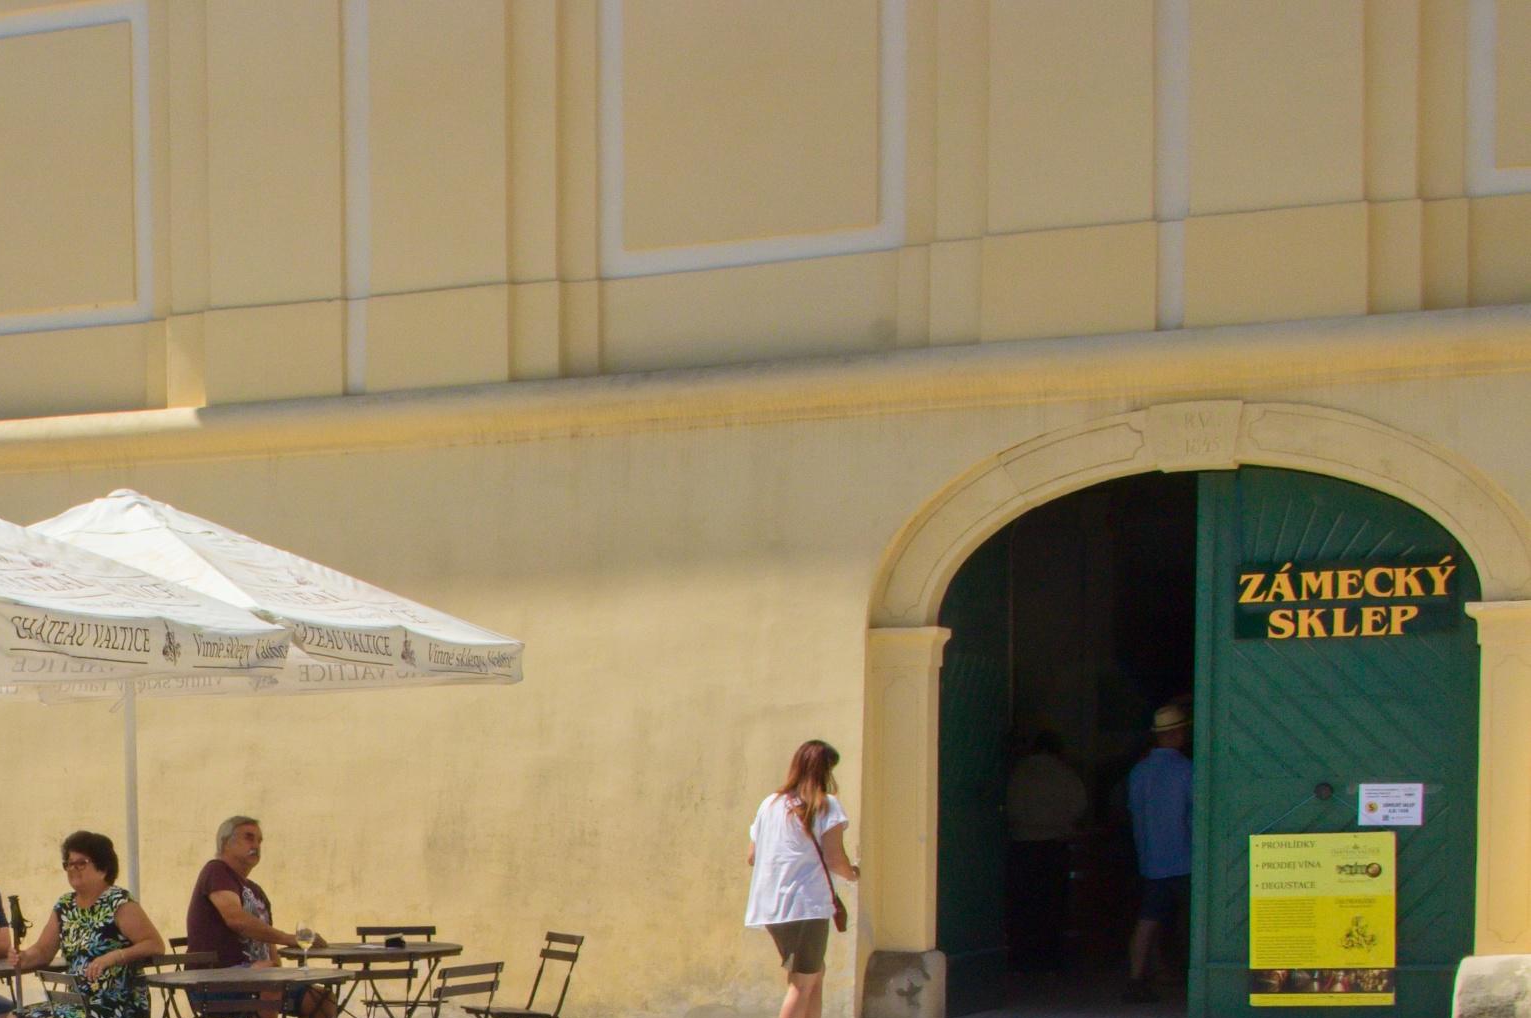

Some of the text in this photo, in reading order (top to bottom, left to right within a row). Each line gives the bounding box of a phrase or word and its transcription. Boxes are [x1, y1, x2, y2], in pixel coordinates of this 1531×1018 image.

[1237, 555, 1456, 604] ZÁMECKÝ
[10, 614, 91, 647] CHÂTEAU
[92, 624, 151, 653] VALTICE
[1267, 605, 1419, 640] SKLEP
[1261, 881, 1317, 890] DEGUSTACE
